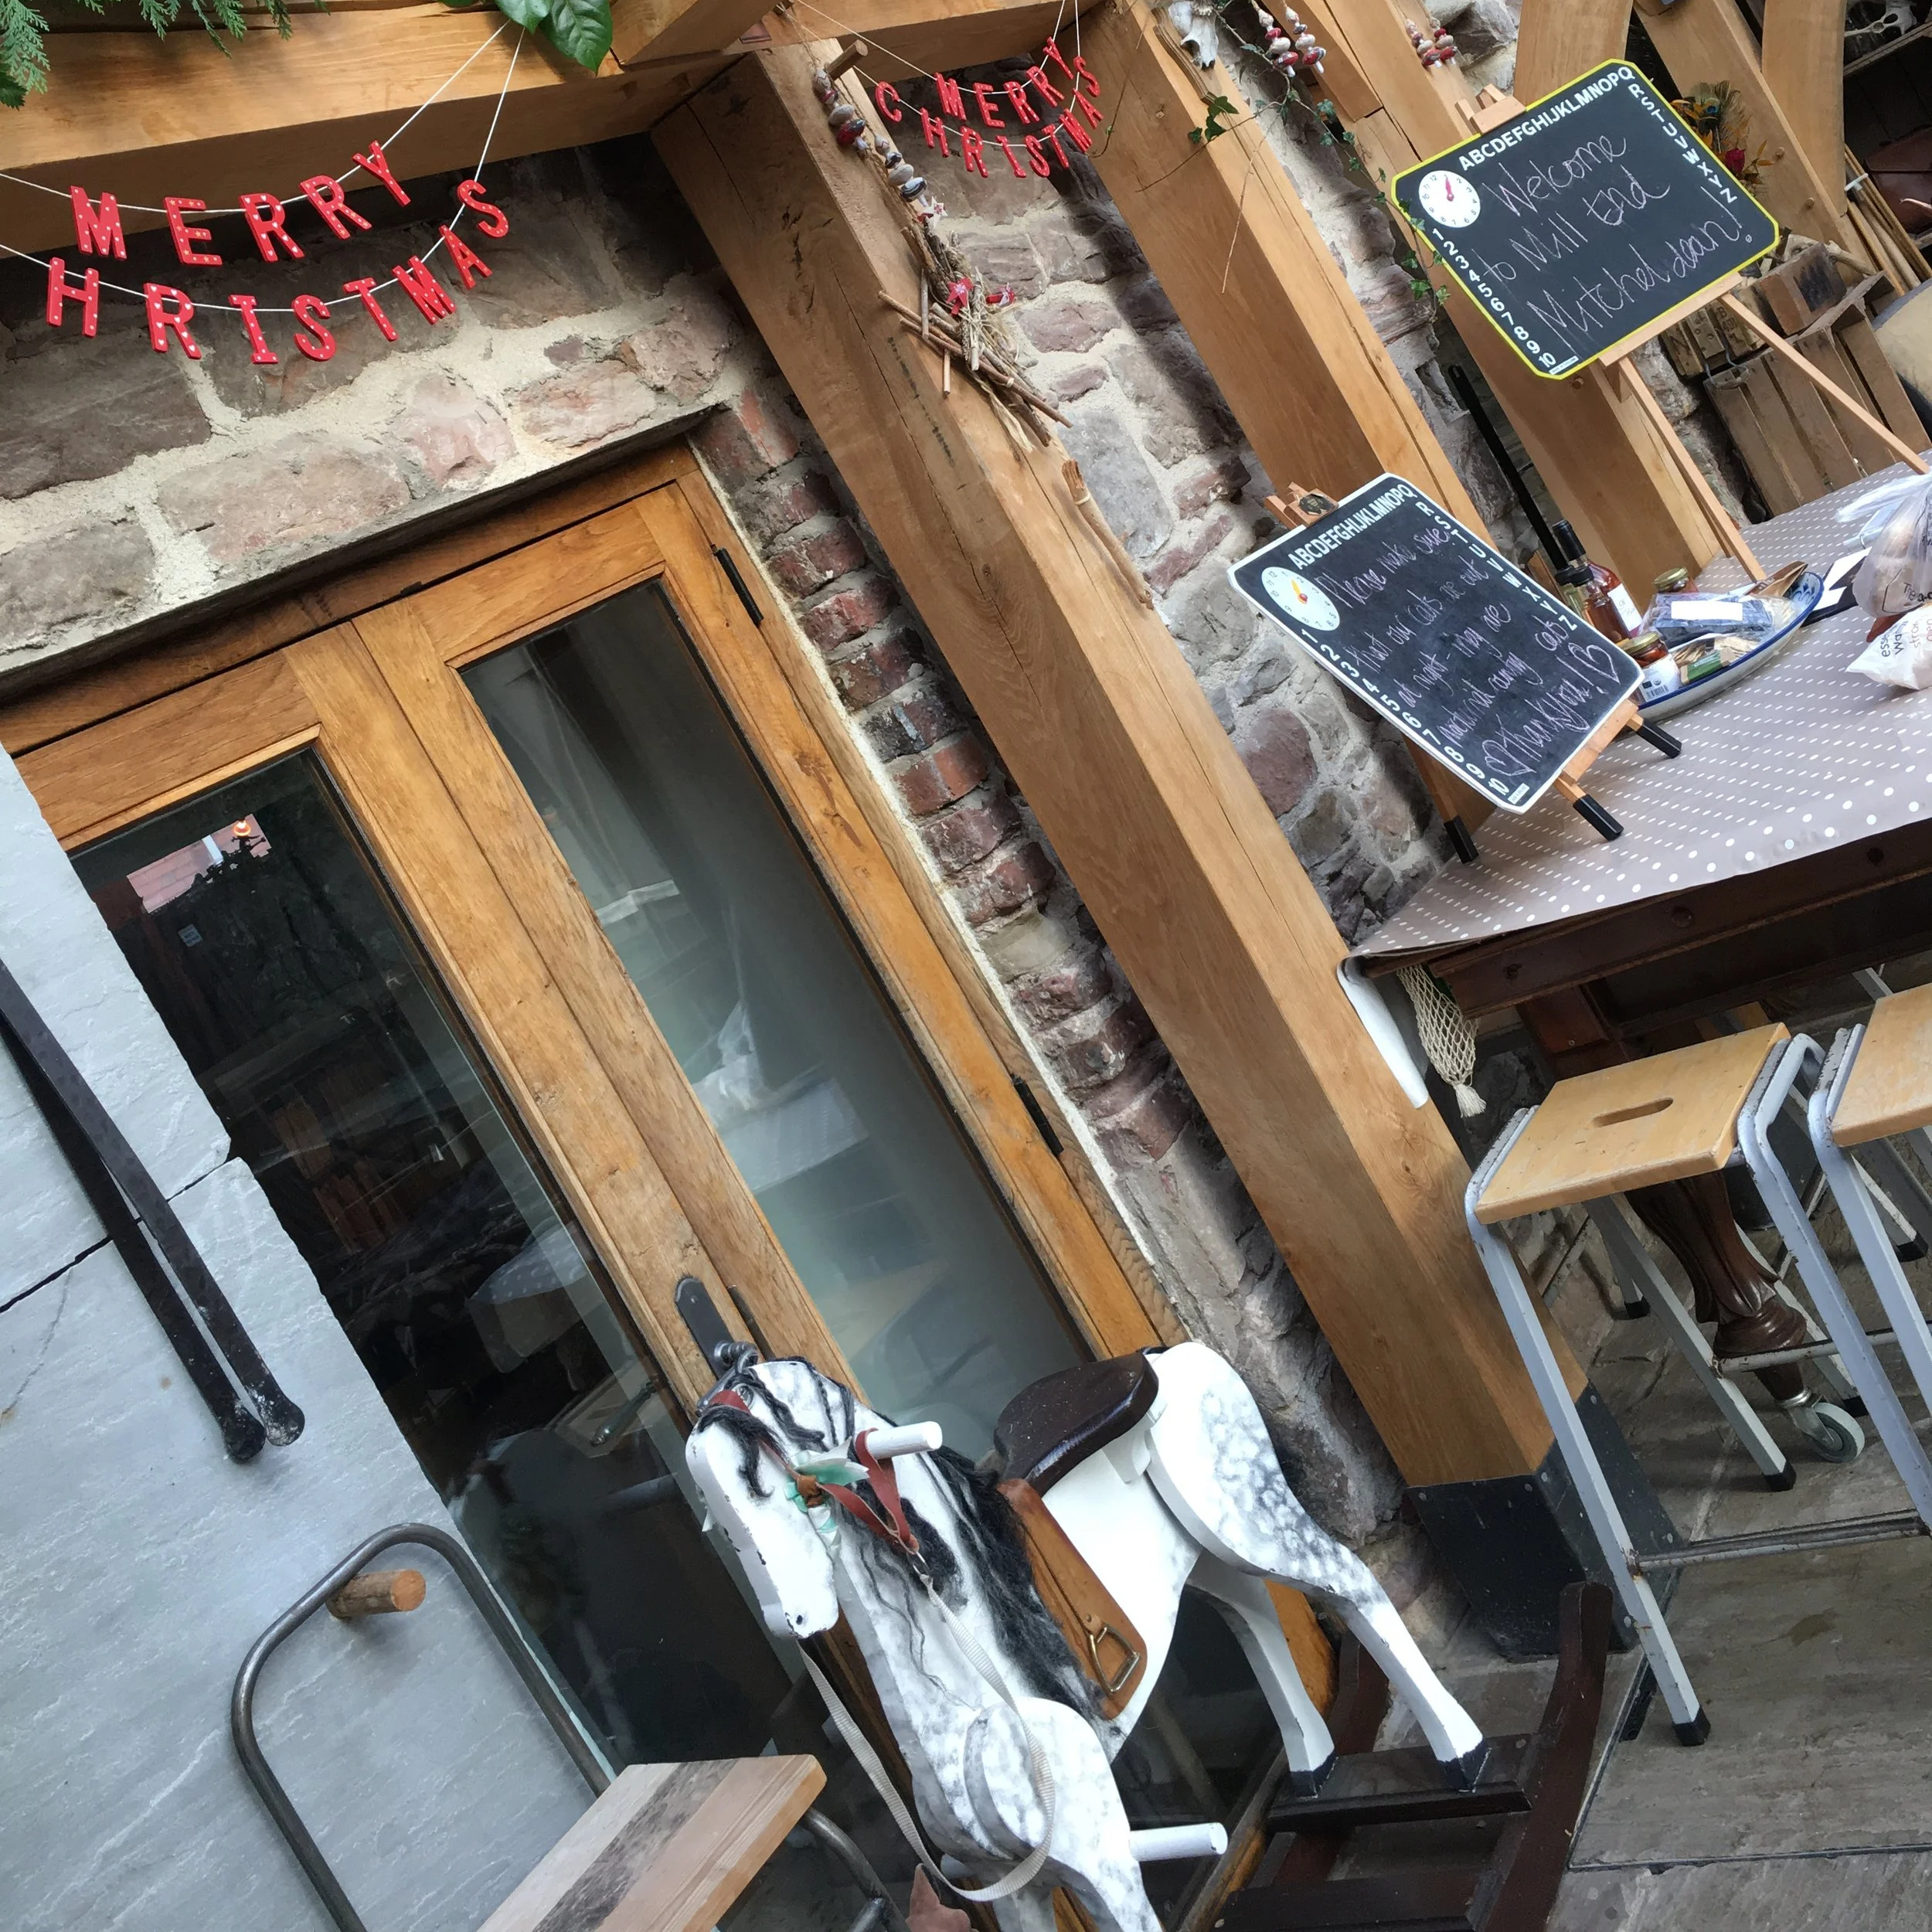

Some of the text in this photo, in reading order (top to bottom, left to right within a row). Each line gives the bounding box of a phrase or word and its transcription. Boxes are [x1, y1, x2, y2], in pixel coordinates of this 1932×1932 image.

[876, 56, 1104, 178] CHRISTMAS
[934, 36, 1073, 128] MERRY
[1459, 66, 1635, 171] ABCDEFGHIJKLMNOPQ
[70, 140, 411, 266] MERRY
[1482, 135, 1627, 216] Welcome
[1471, 248, 1517, 282] to
[1509, 211, 1588, 271] Mill
[1288, 484, 1417, 570] ABCDEFGHIJKLMNOPQ
[1314, 569, 1387, 609] Please
[1376, 541, 1417, 574] make
[1386, 614, 1417, 645] our
[1406, 589, 1443, 626] cats
[1458, 555, 1489, 586] out
[1393, 679, 1422, 708] at
[1413, 651, 1454, 696] night
[1483, 602, 1512, 633] are
[1531, 614, 1570, 651] cats
